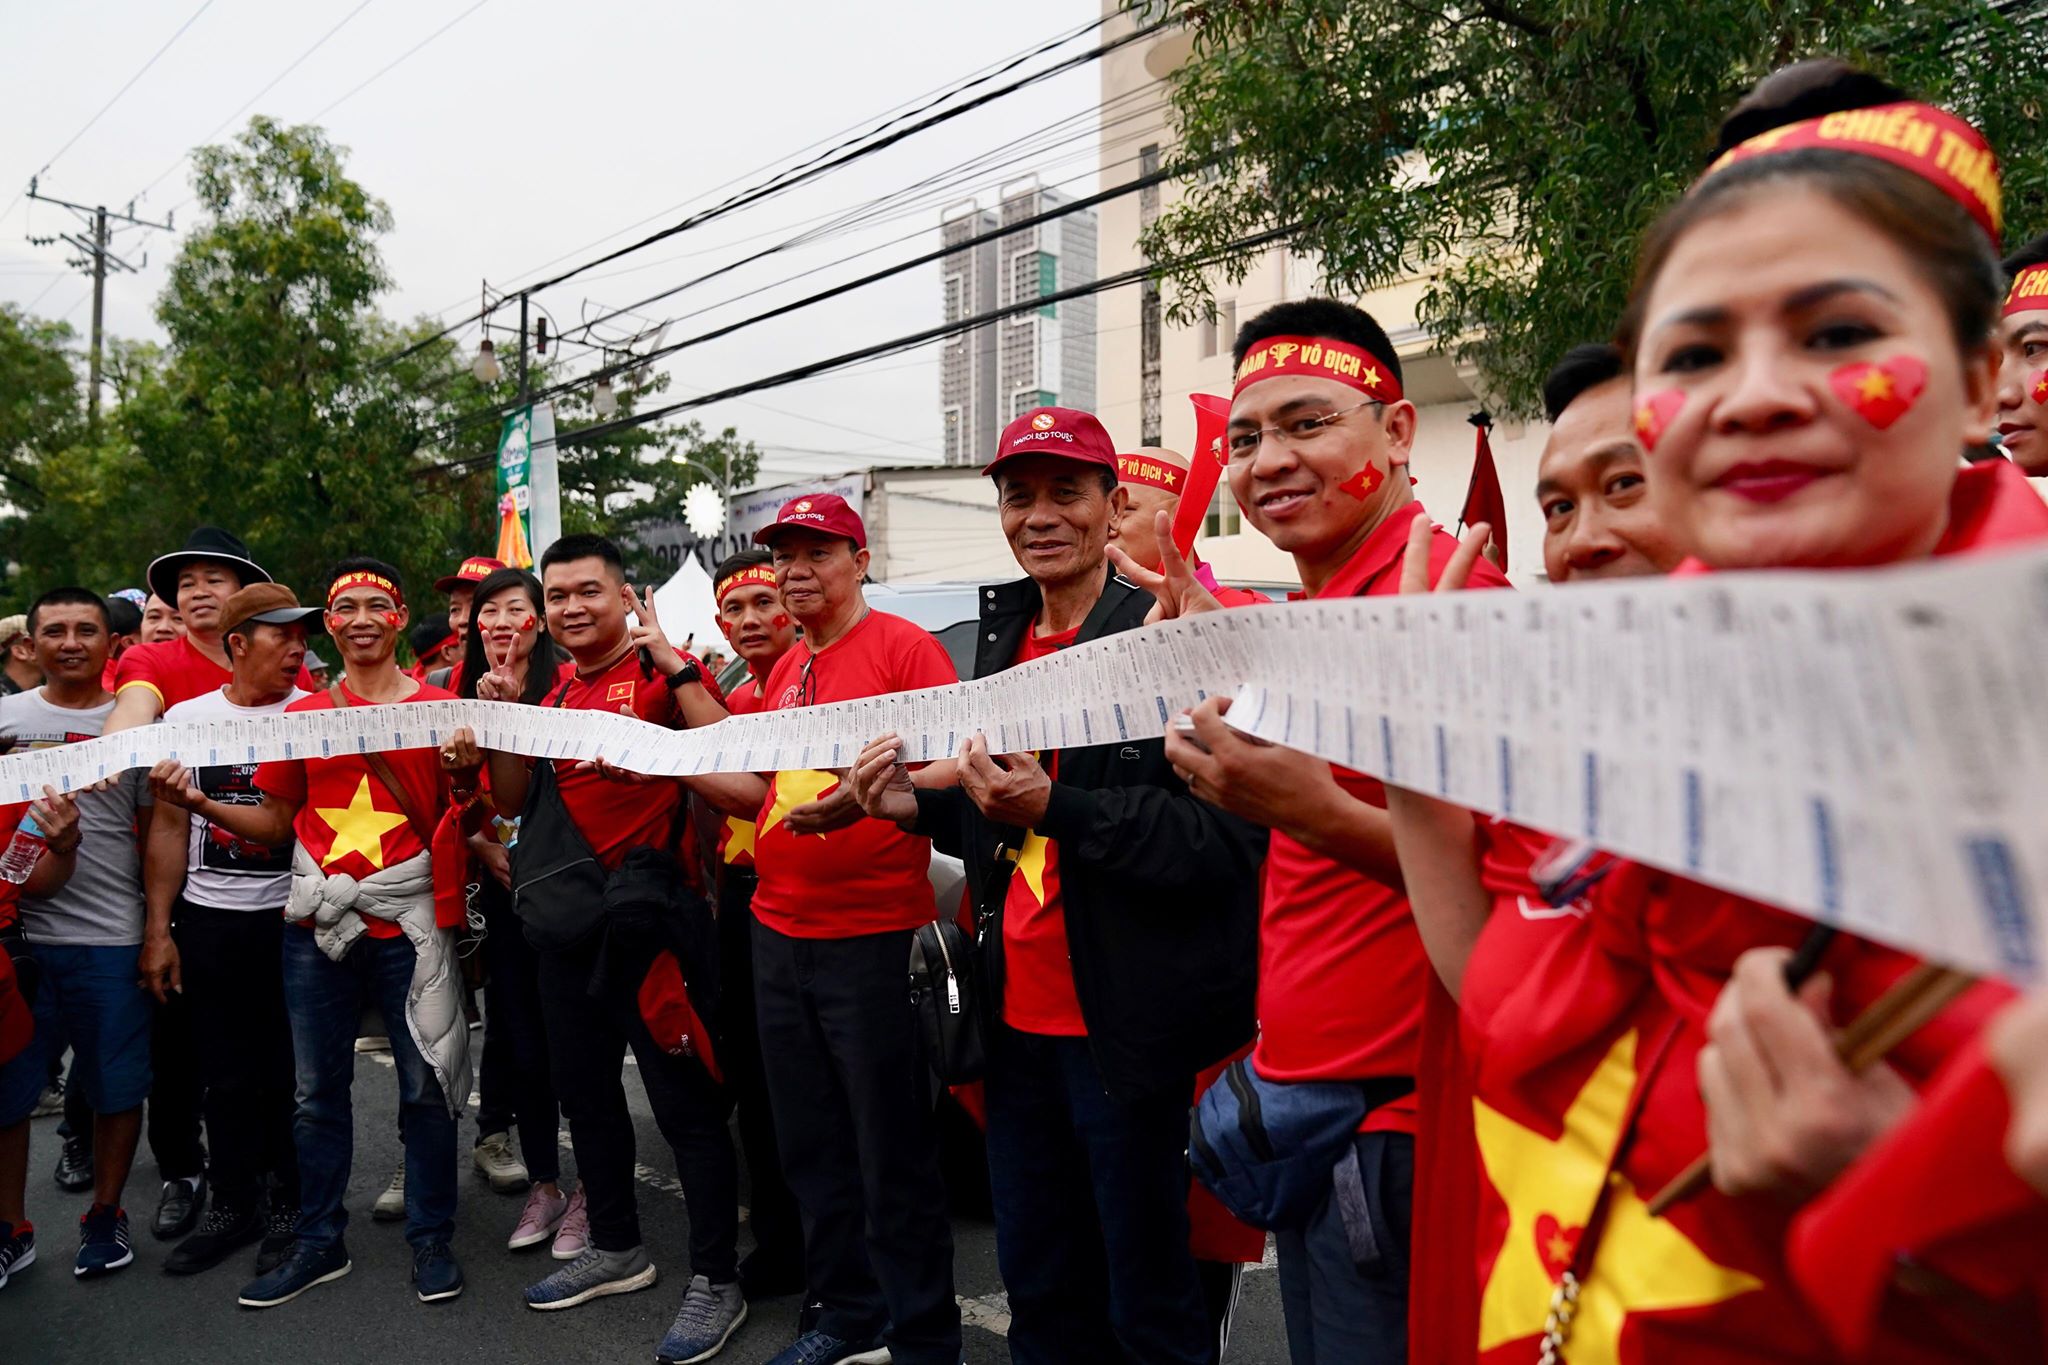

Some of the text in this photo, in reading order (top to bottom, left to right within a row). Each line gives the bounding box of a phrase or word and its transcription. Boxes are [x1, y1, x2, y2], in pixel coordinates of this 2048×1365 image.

[1300, 343, 1323, 366] VÔ
[1323, 348, 1362, 378] ĐỊCH
[1050, 431, 1074, 443] TOURS
[1127, 458, 1162, 481] VÔ ĐỊCH
[747, 567, 759, 579] VÔ
